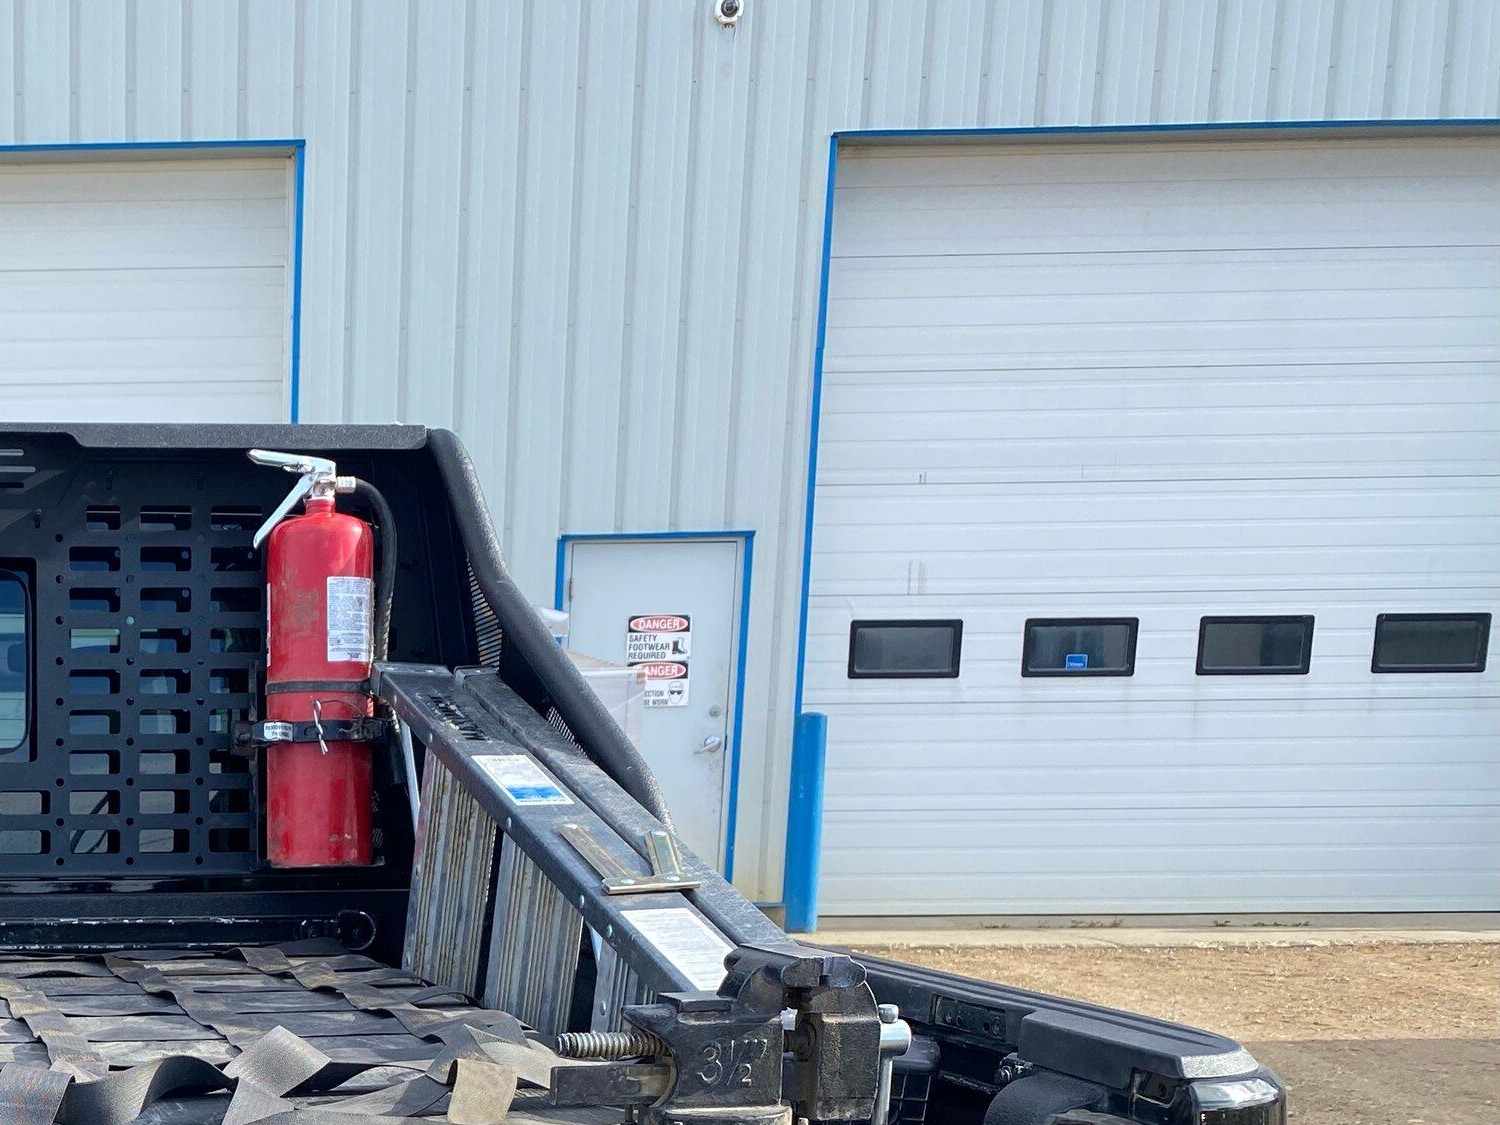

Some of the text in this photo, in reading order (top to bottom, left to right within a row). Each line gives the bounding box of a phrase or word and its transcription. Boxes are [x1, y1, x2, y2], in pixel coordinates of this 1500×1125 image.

[638, 618, 680, 630] DANGER
[629, 634, 658, 642] SAFETY
[628, 643, 670, 651] FOOTWEAR
[628, 651, 666, 660] REQUIRED
[644, 665, 678, 676] ANGER
